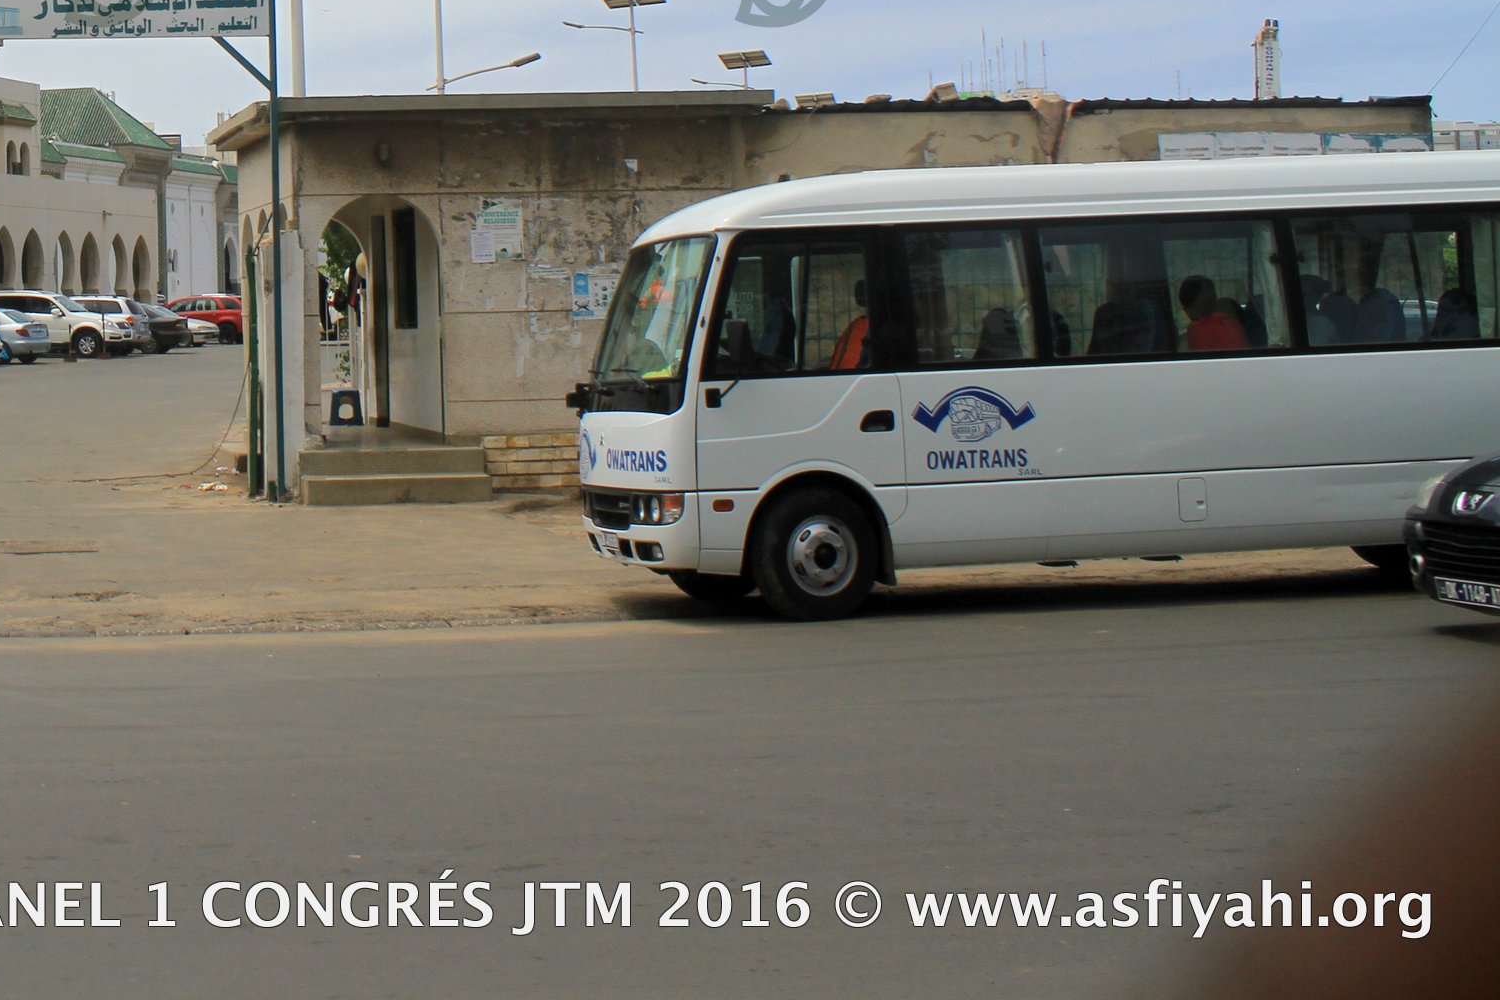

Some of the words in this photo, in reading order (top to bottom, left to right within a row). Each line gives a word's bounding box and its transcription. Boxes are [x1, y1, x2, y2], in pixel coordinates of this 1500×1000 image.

[51, 18, 87, 38] النشر
[89, 24, 100, 37] و
[102, 18, 152, 37] الوثائق
[165, 17, 204, 35] البحث
[218, 15, 258, 33] التعليم
[606, 447, 668, 473] OWATRANS
[926, 448, 1028, 470] OWATRANS
[1017, 468, 1043, 476] SARL
